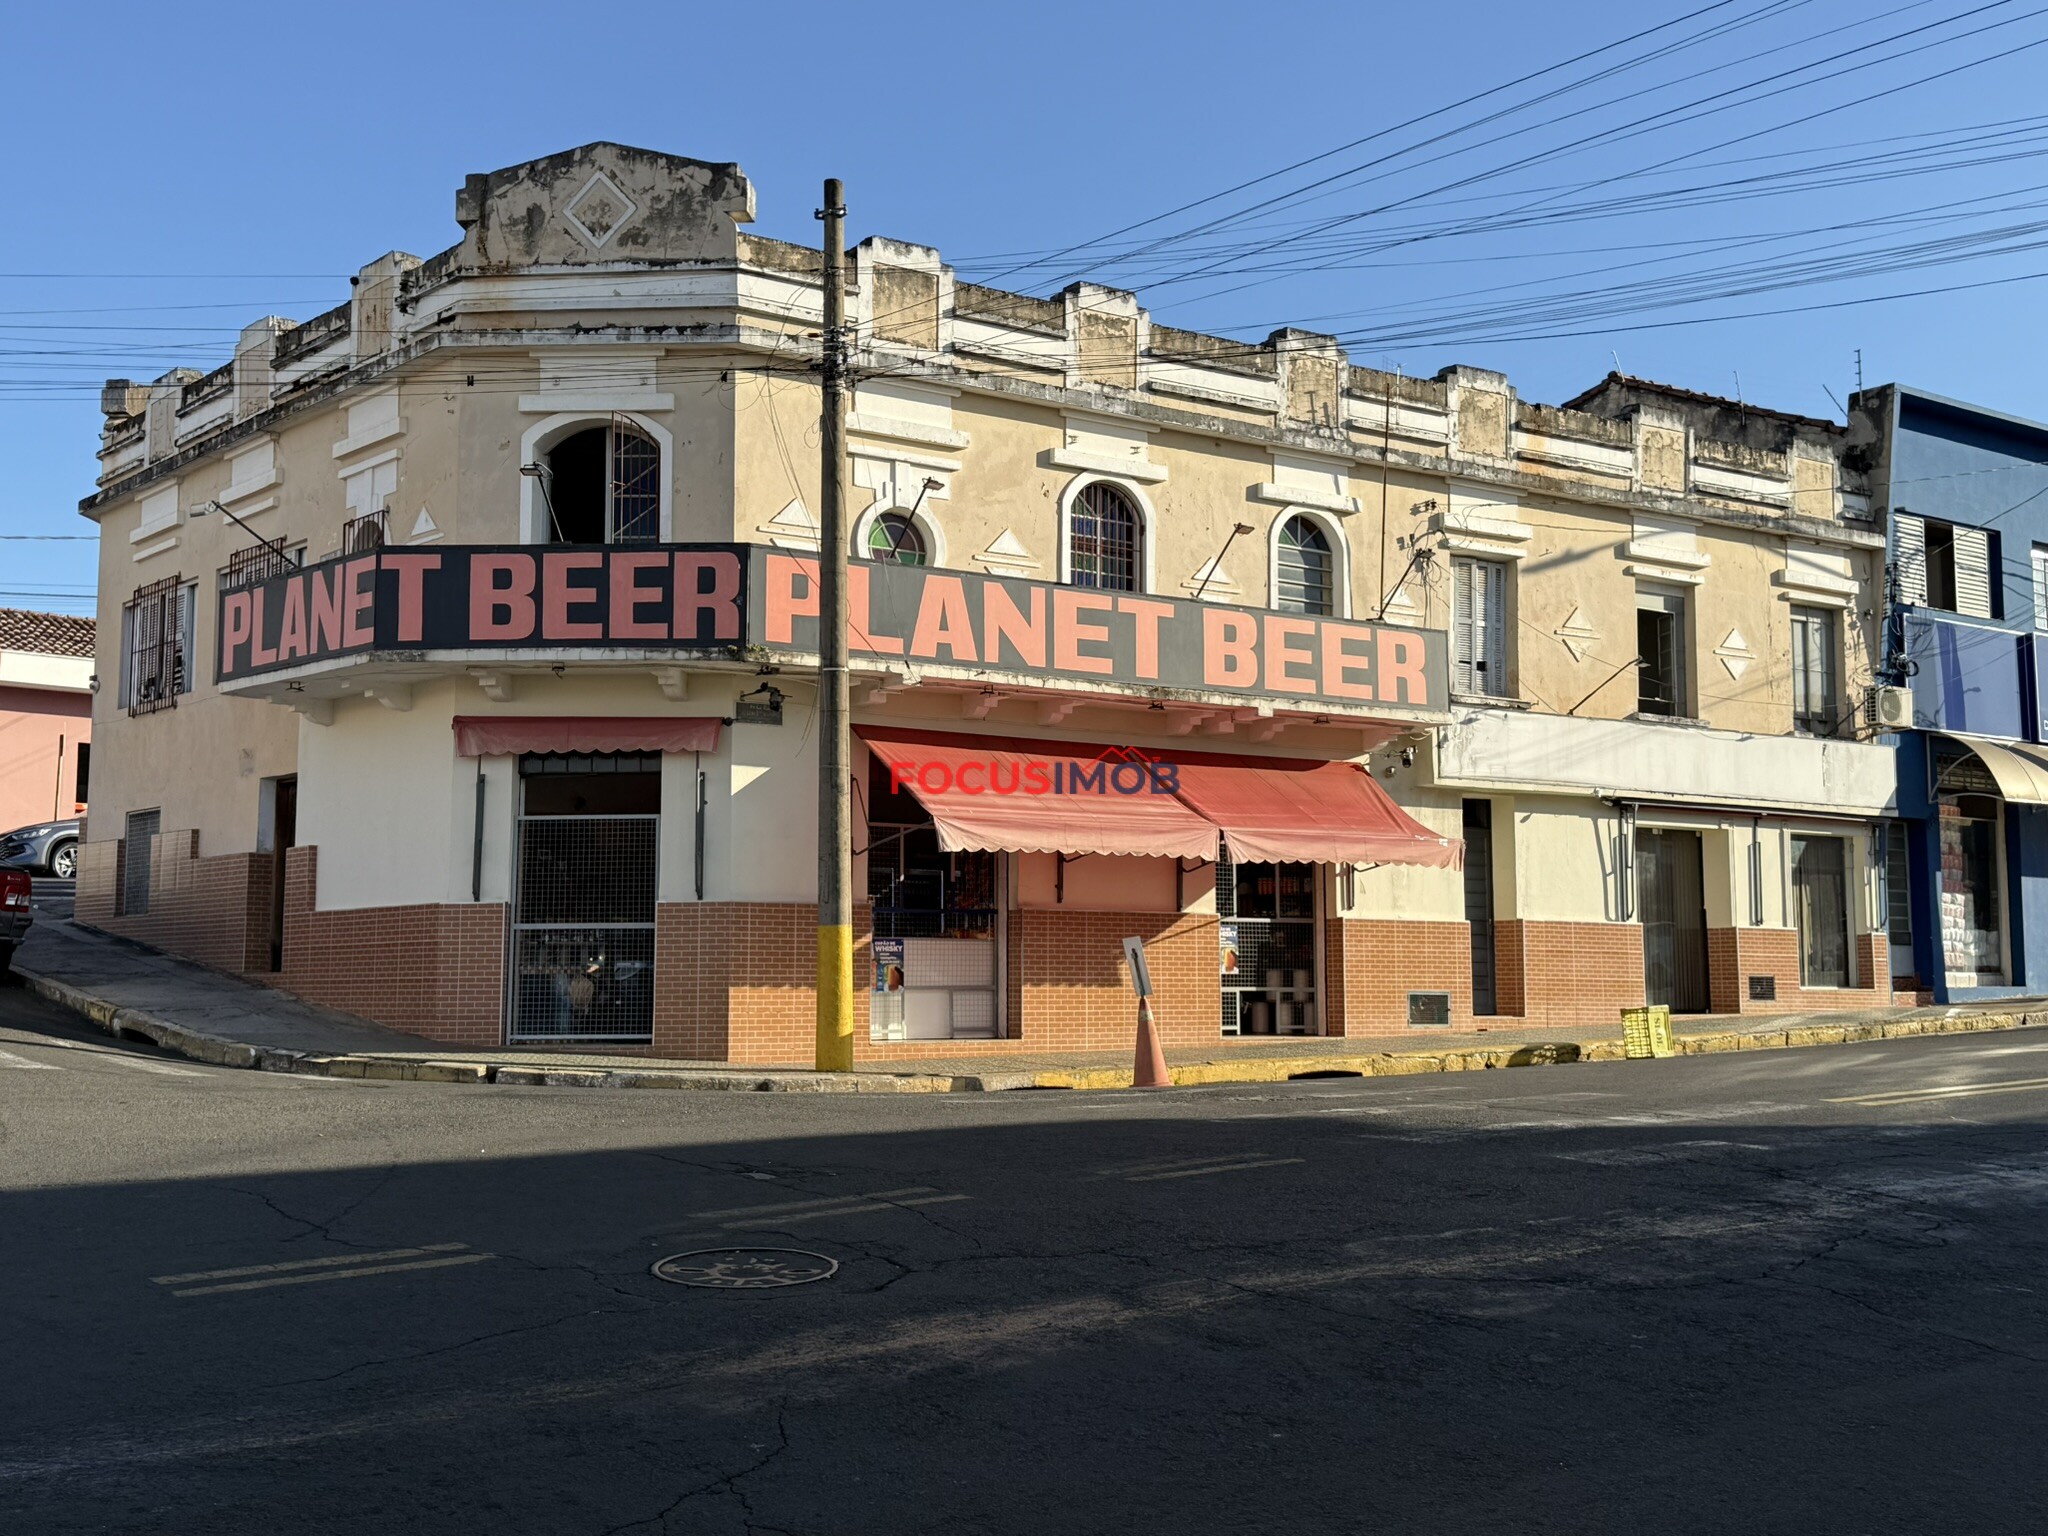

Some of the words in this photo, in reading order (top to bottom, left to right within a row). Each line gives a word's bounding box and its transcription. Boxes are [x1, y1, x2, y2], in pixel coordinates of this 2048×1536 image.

[222, 553, 442, 674] PLANET
[469, 551, 741, 640] BEER
[765, 554, 1174, 680] PLANET
[1202, 606, 1428, 705] BEER
